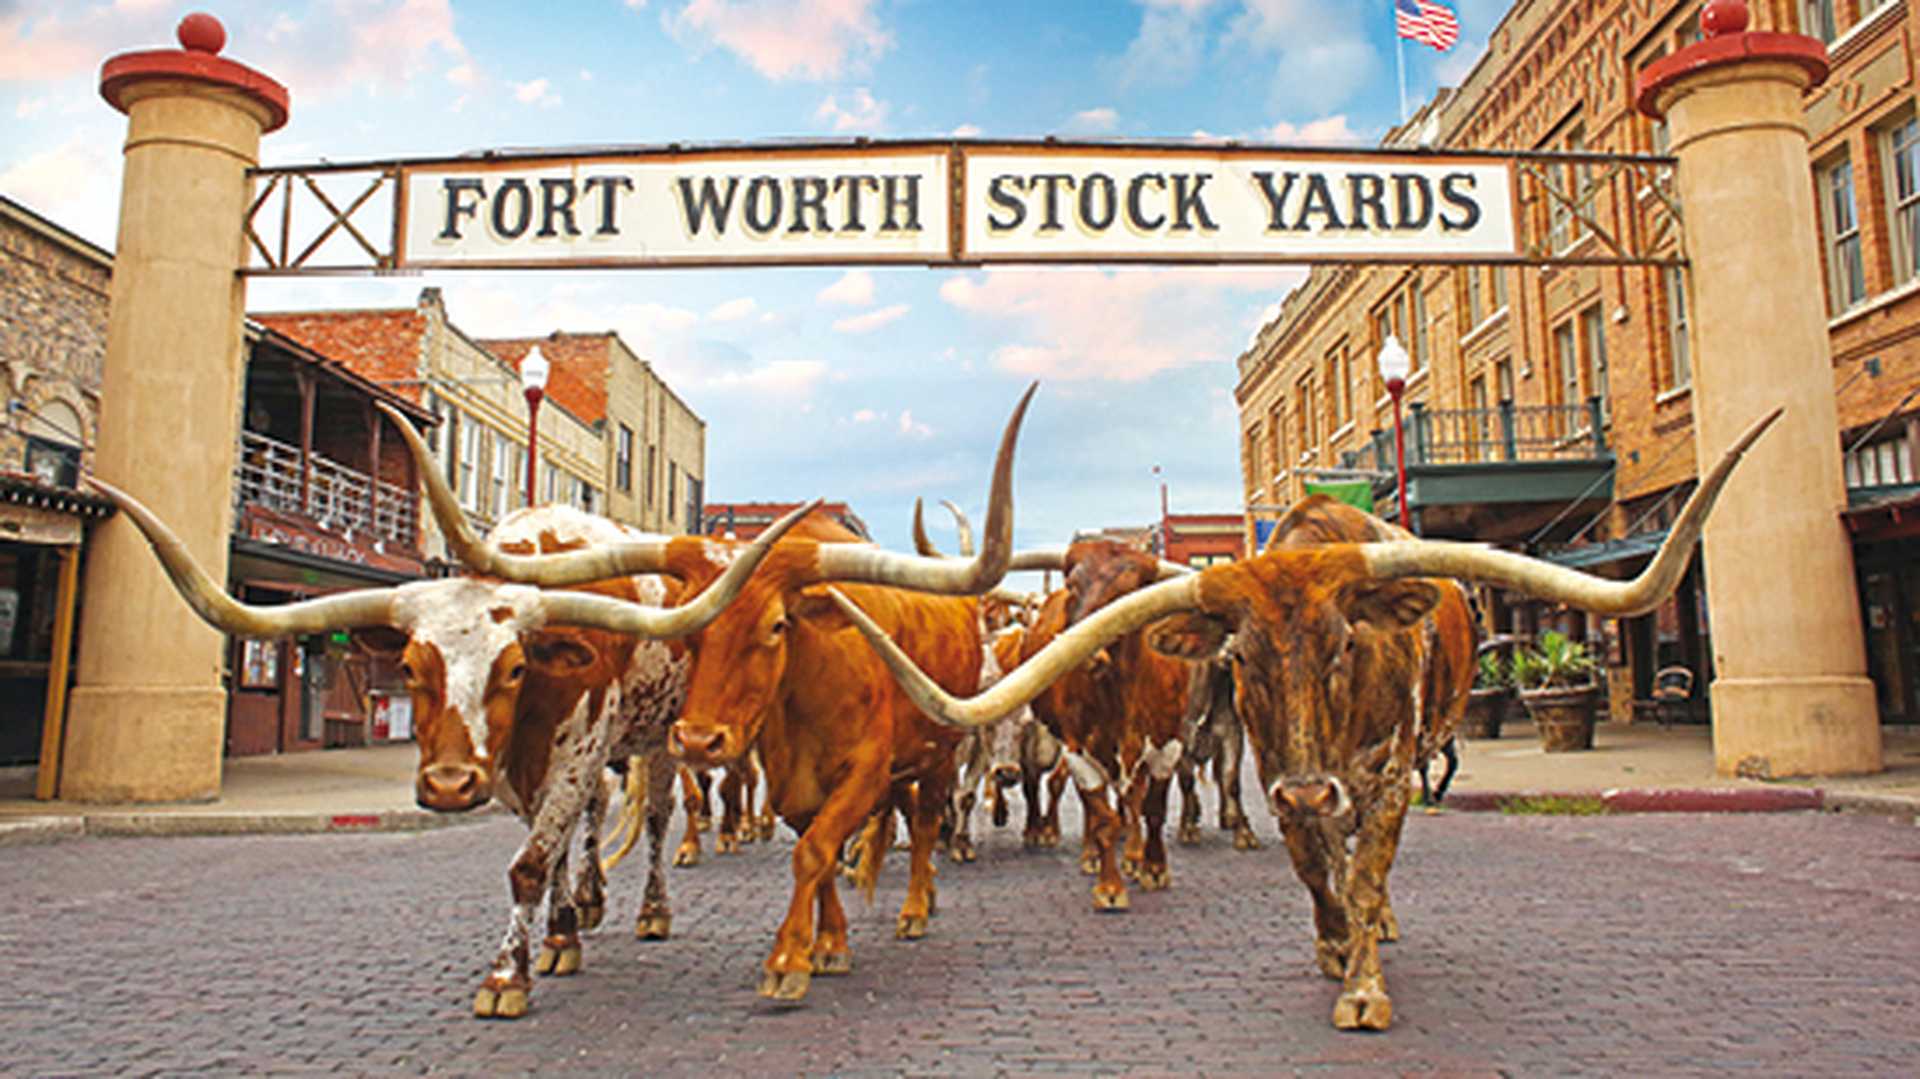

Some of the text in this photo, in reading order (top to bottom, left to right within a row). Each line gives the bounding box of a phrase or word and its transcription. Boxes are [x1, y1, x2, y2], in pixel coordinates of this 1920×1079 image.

[438, 171, 1482, 240] FORT WORTH STOCK YARDS
